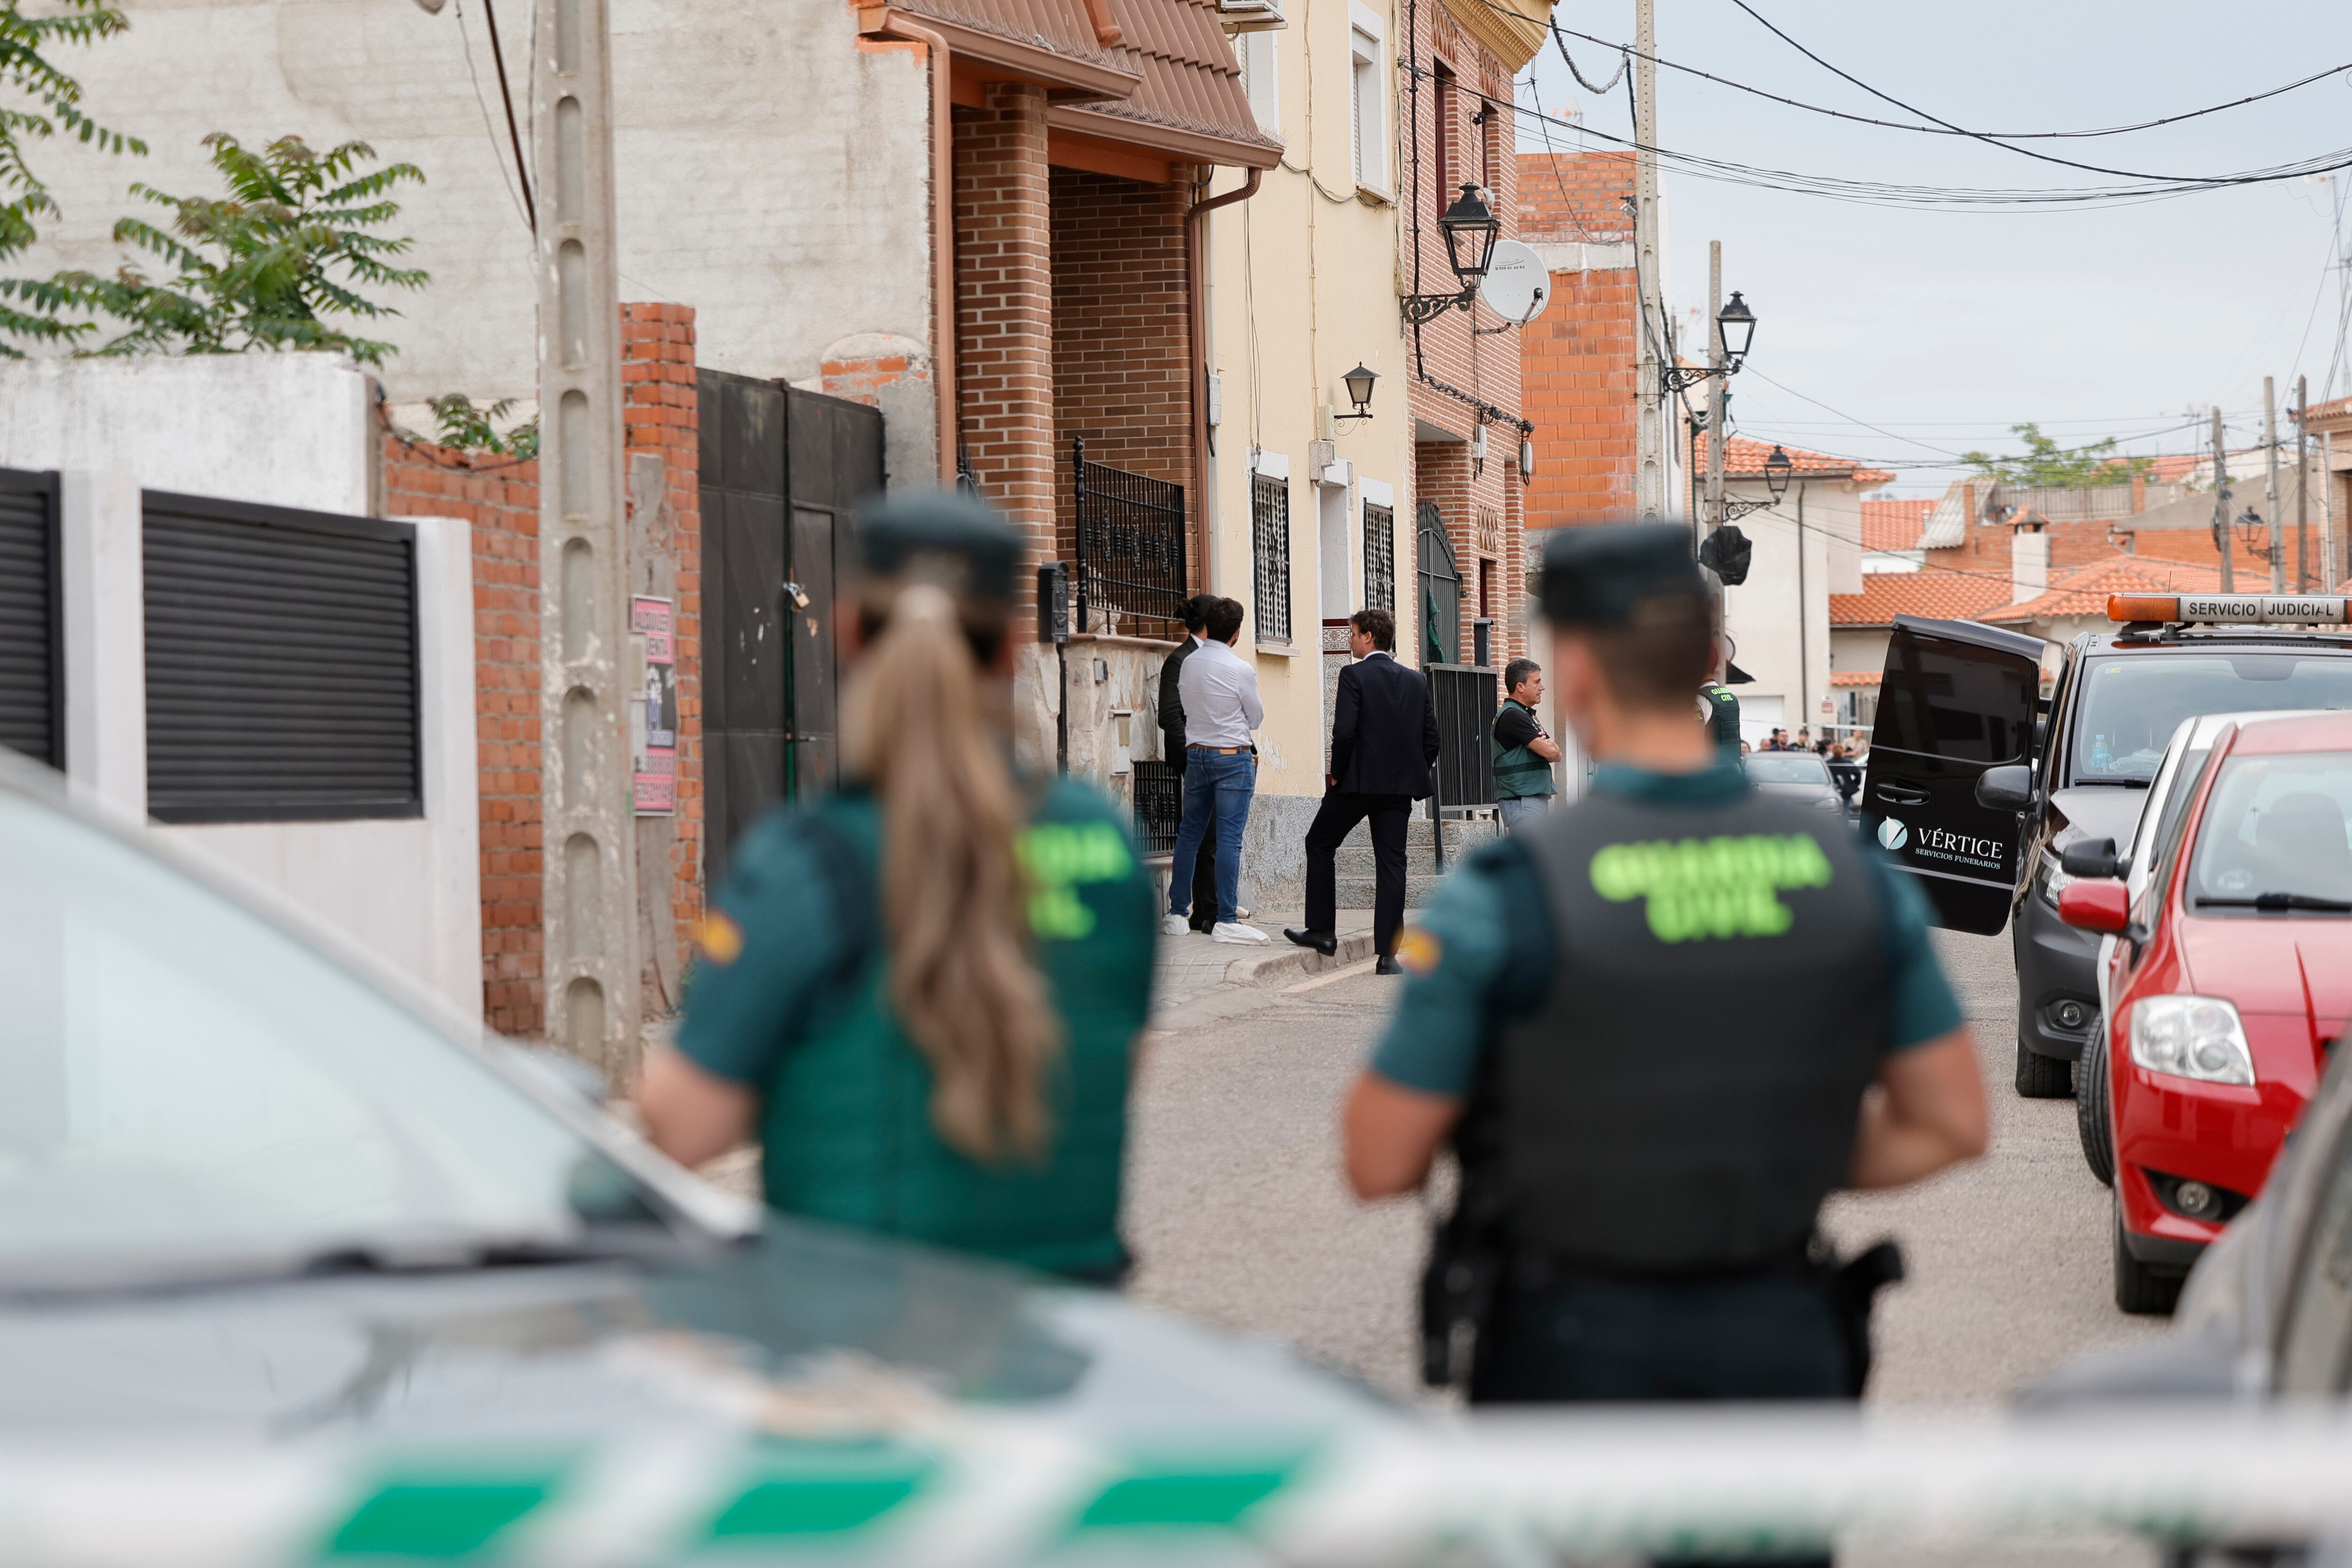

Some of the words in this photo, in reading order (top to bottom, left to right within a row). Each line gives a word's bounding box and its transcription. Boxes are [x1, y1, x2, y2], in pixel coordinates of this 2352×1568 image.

[2189, 602, 2256, 617] SERVICIO
[1918, 828, 2003, 859] VÉRTICE
[1915, 847, 1953, 861] SERVICIOS
[1955, 855, 2001, 870] FUNERARIOS
